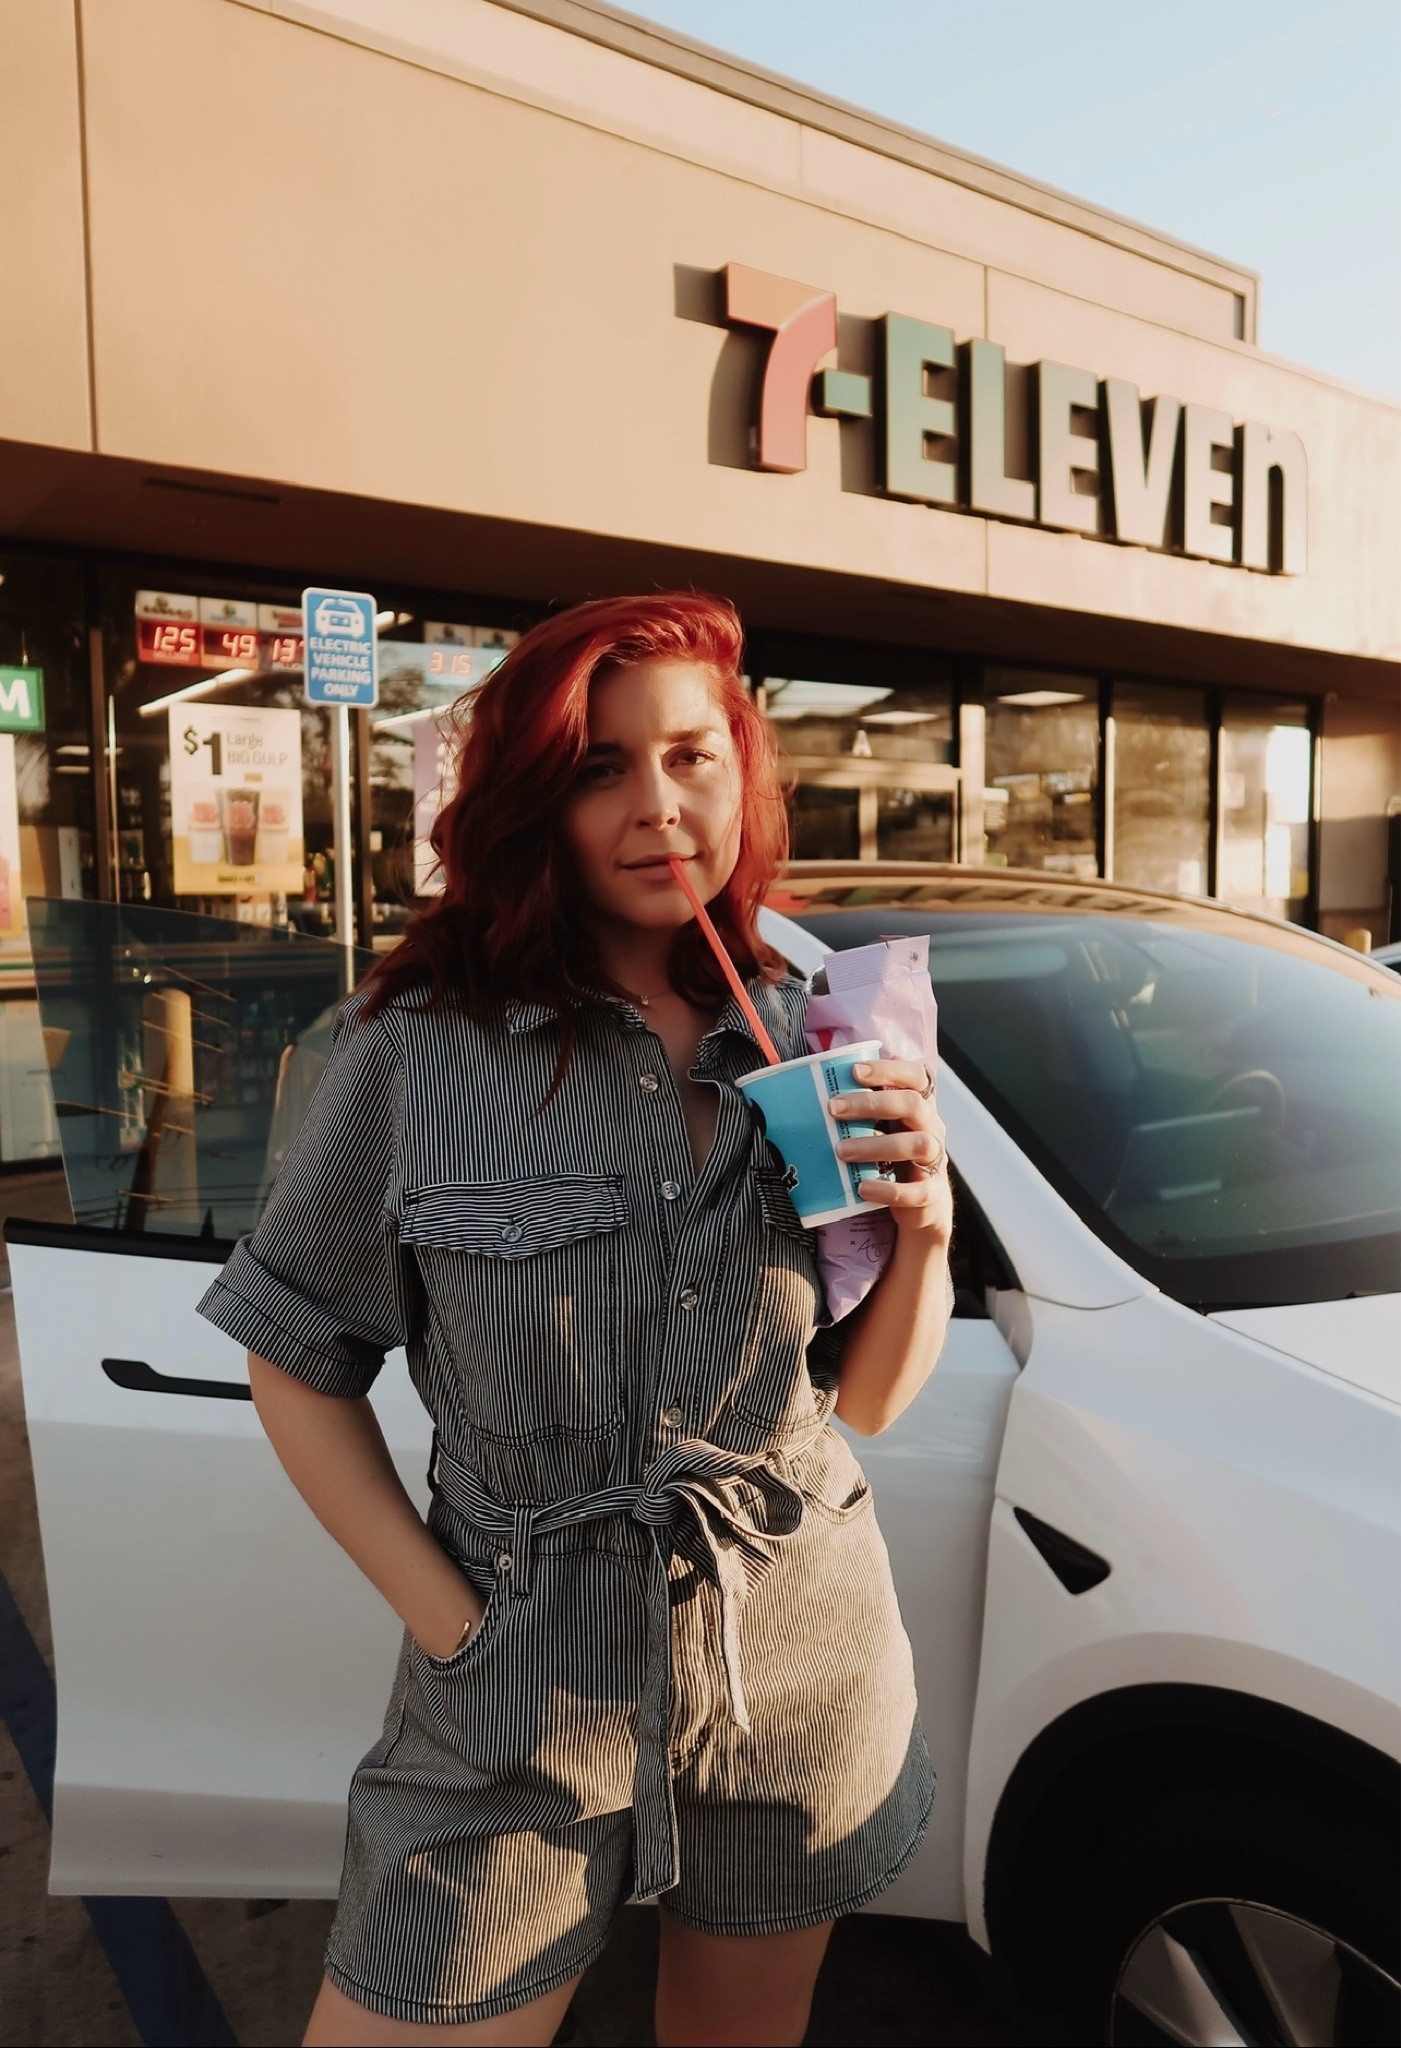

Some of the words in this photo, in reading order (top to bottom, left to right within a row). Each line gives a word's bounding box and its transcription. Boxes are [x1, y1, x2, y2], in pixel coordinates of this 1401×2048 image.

[153, 626, 197, 654] 125
[222, 633, 256, 659] 49
[309, 636, 372, 654] ELECTRIC
[272, 638, 304, 663] 13
[313, 651, 369, 669] VEHICLE
[310, 666, 372, 685] PARKING
[323, 682, 359, 697] ONLY
[226, 732, 264, 750] Large
[183, 725, 222, 776] $1
[227, 750, 250, 765] BIG
[252, 751, 288, 766] GULP
